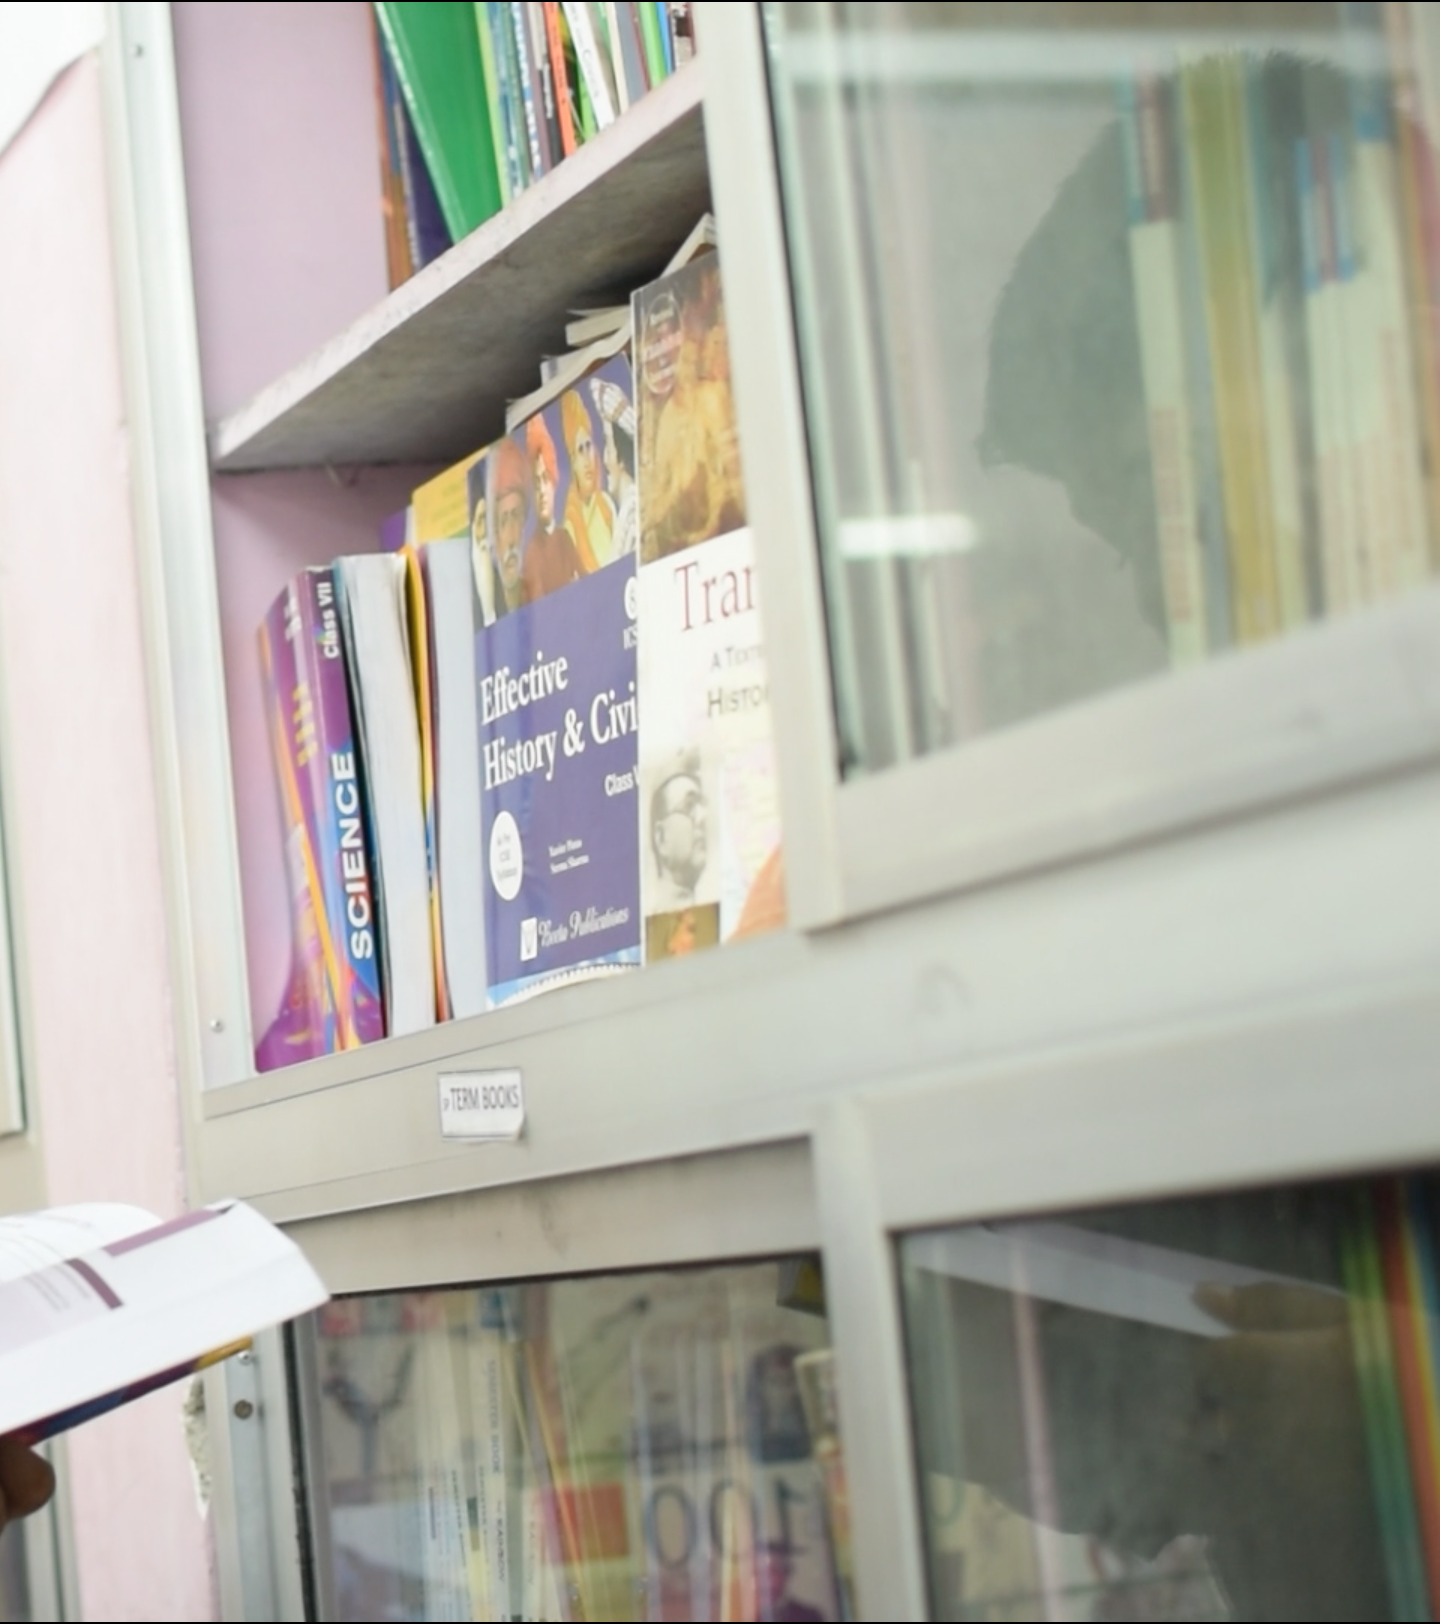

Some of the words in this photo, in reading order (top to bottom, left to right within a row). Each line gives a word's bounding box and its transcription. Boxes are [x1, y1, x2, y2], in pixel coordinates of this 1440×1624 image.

[317, 581, 334, 607] VII
[322, 609, 340, 659] Class
[480, 650, 569, 726] Effective
[483, 730, 558, 791] History
[563, 708, 585, 757] &
[590, 681, 638, 745] Civi
[604, 770, 634, 797] Class
[331, 752, 373, 960] SCIENCE
[569, 906, 630, 940] Publications
[450, 1087, 480, 1111] TERM
[482, 1084, 519, 1110] BOOKS
